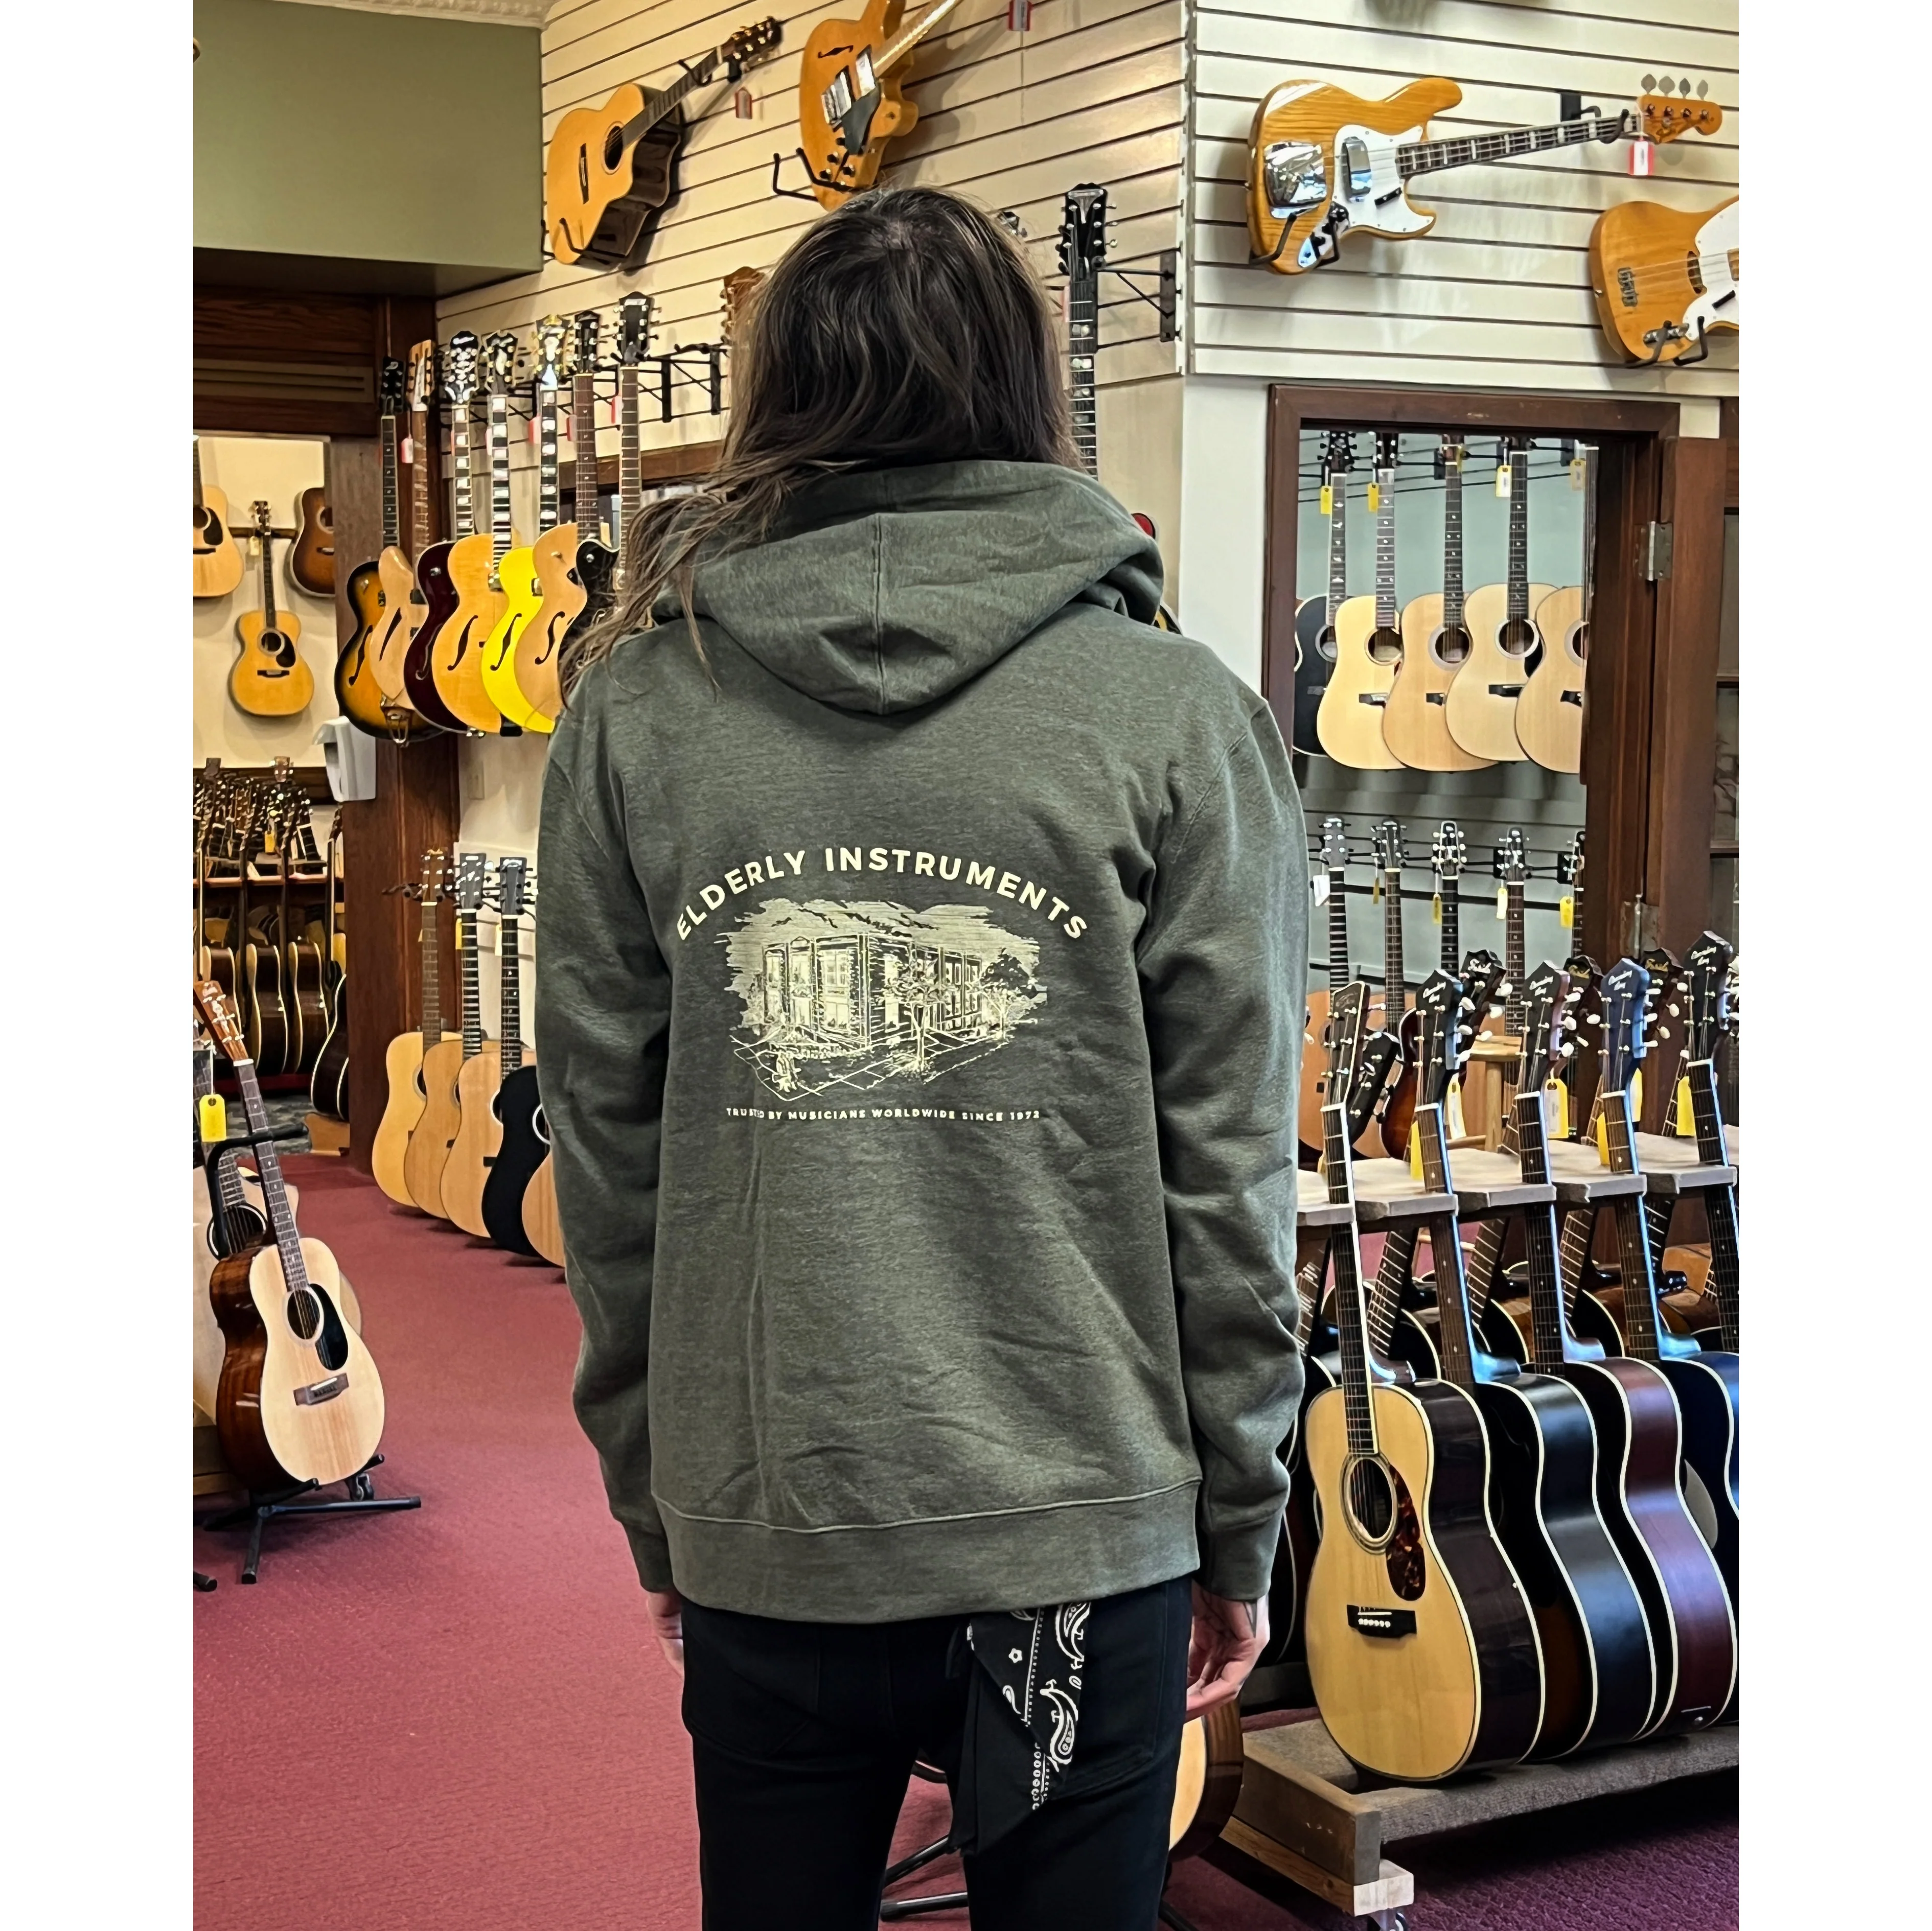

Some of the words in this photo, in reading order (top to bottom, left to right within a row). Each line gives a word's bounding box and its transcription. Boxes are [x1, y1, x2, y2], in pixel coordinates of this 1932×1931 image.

[676, 849, 806, 941] ELDERLY
[824, 846, 1088, 940] INSTRUMENTS
[768, 1110, 783, 1120] BY
[788, 1109, 866, 1120] MUSICIANS
[871, 1108, 955, 1120] WORLDWIDE
[961, 1111, 1003, 1122] SINCE
[1009, 1110, 1040, 1121] 1972
